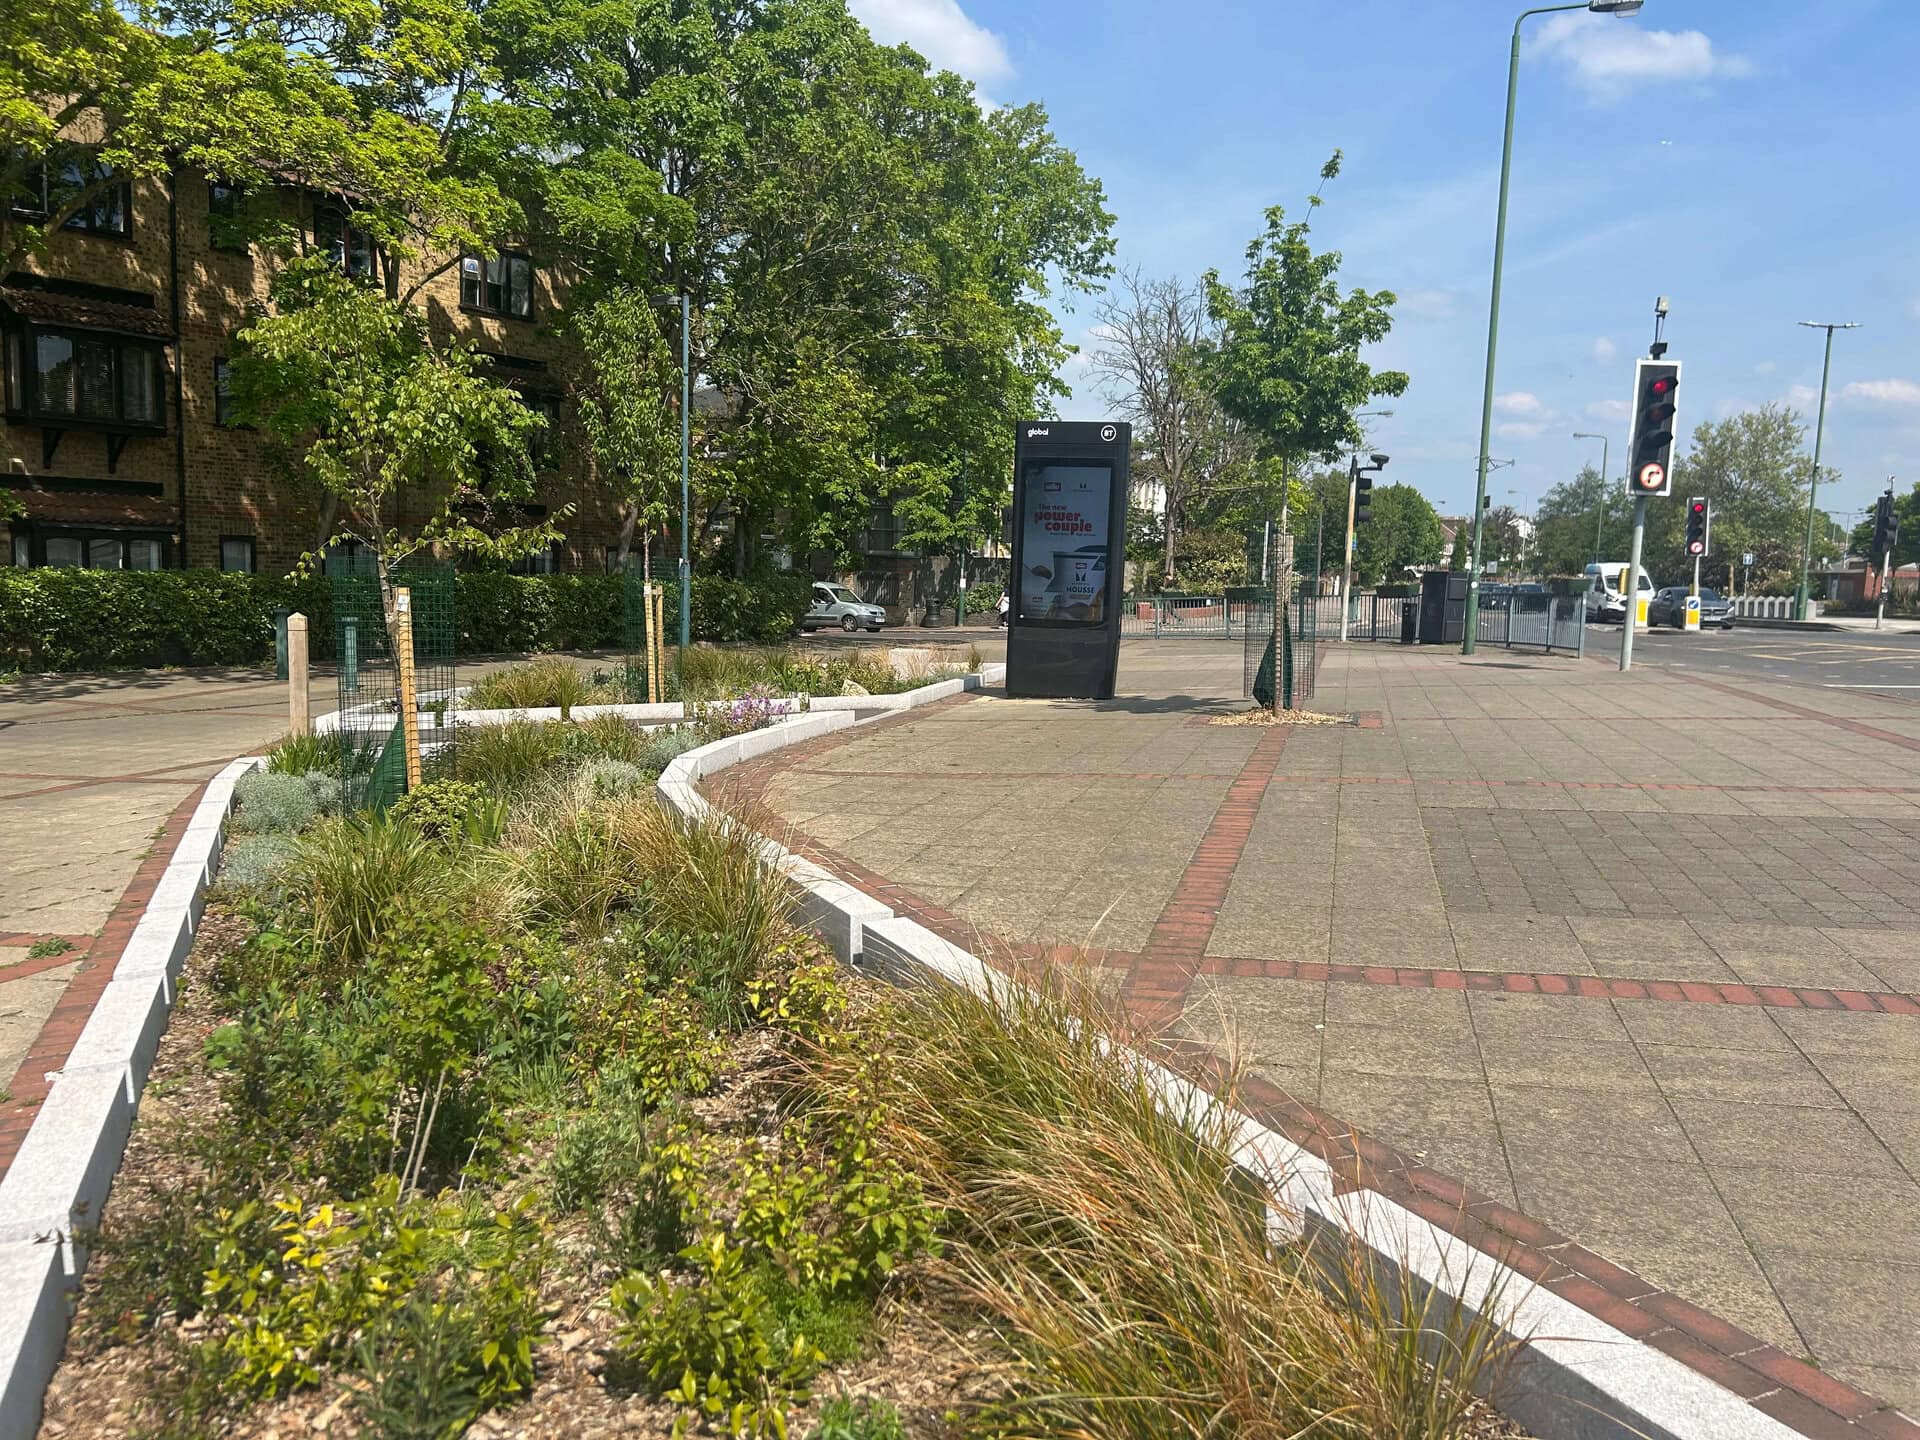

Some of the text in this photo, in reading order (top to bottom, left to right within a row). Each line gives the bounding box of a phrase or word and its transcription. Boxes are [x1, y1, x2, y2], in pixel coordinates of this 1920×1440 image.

[1027, 428, 1049, 438] global
[1035, 511, 1081, 524] power
[1045, 519, 1093, 533] couple
